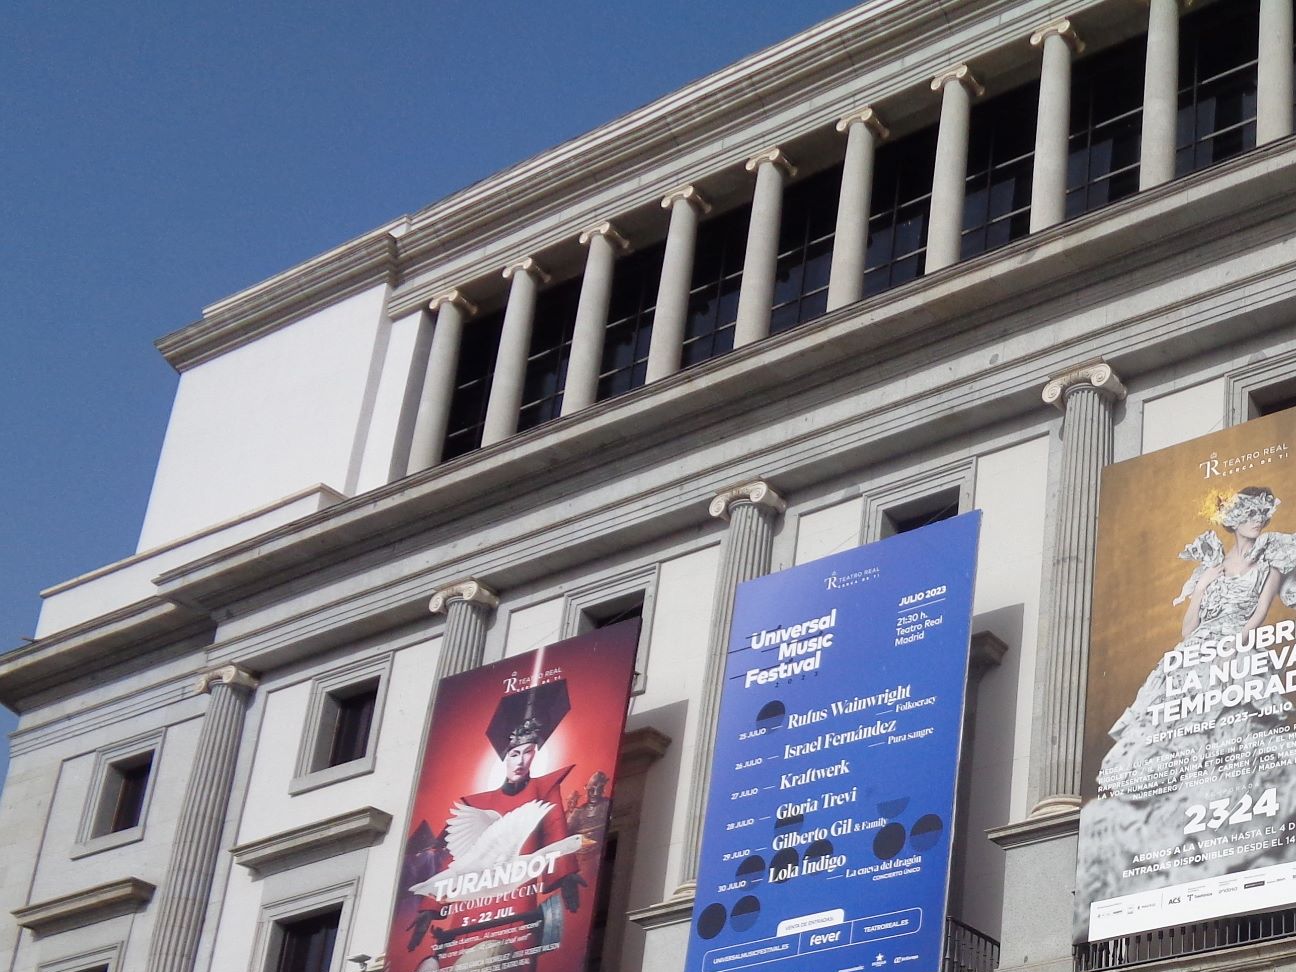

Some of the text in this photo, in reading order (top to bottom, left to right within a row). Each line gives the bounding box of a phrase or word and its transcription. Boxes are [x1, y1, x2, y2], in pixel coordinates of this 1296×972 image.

[1223, 443, 1288, 468] TEATRO REAL
[1222, 464, 1253, 476] CERCA
[839, 567, 880, 582] TEATRO REAL
[898, 585, 947, 606] JULIO 2023
[751, 609, 837, 650] Universal
[895, 615, 943, 636] Teatro Real
[896, 613, 918, 626] 21:30
[778, 632, 834, 660] Music
[894, 631, 924, 647] Madrid
[744, 652, 821, 688] Festival
[1165, 670, 1202, 698] LA
[787, 708, 828, 730] Rufus
[831, 684, 911, 717] Wainwright
[895, 696, 937, 713] Folkocracy
[783, 741, 821, 759] Israel
[824, 720, 897, 748] Fernández
[888, 727, 934, 745] Pura sangre
[1145, 720, 1216, 745] SEPTIEMBRE
[1205, 736, 1242, 750] ORLANDO
[1252, 725, 1290, 739] ORLANDO
[1240, 740, 1265, 751] PATRIA
[1276, 735, 1285, 743] EL
[1167, 776, 1177, 784] LA
[1180, 770, 1208, 782] ESPERA
[1218, 760, 1250, 772] CARMEN
[1260, 754, 1274, 763] LOS
[1179, 762, 1203, 774] ANIMA
[1204, 760, 1214, 768] ET
[1225, 752, 1250, 762] CORPO
[1258, 745, 1278, 755] DIDO
[1185, 775, 1218, 788] TENORIO
[1258, 759, 1293, 772] MADAMA
[780, 759, 850, 790] Kraftwerk
[776, 799, 818, 820] Gloria
[821, 787, 857, 809] Trevi
[731, 817, 887, 859] JULIO Gilberto Gil Family
[1132, 847, 1172, 864] ABONOS
[1173, 846, 1180, 855] A
[1182, 843, 1195, 852] LA
[1198, 835, 1228, 849] VENTA
[1231, 829, 1262, 842] HASTA
[1265, 826, 1277, 835] EL
[1280, 823, 1285, 831] 4
[846, 869, 856, 878] La
[880, 860, 892, 871] del
[894, 855, 922, 868] dragón
[1122, 860, 1172, 878] ENTRADAS
[1173, 848, 1234, 866] DISPONIBLES
[1237, 841, 1269, 854] DESDE
[1271, 837, 1284, 847] EL
[1286, 835, 1296, 845] 14
[434, 851, 561, 902] TURANDOT
[726, 854, 846, 890] JULIO Lola Índigo
[440, 882, 545, 917] GIACOMO PUCCINI
[461, 907, 516, 926] 3 22 JUL
[809, 930, 841, 946] fever
